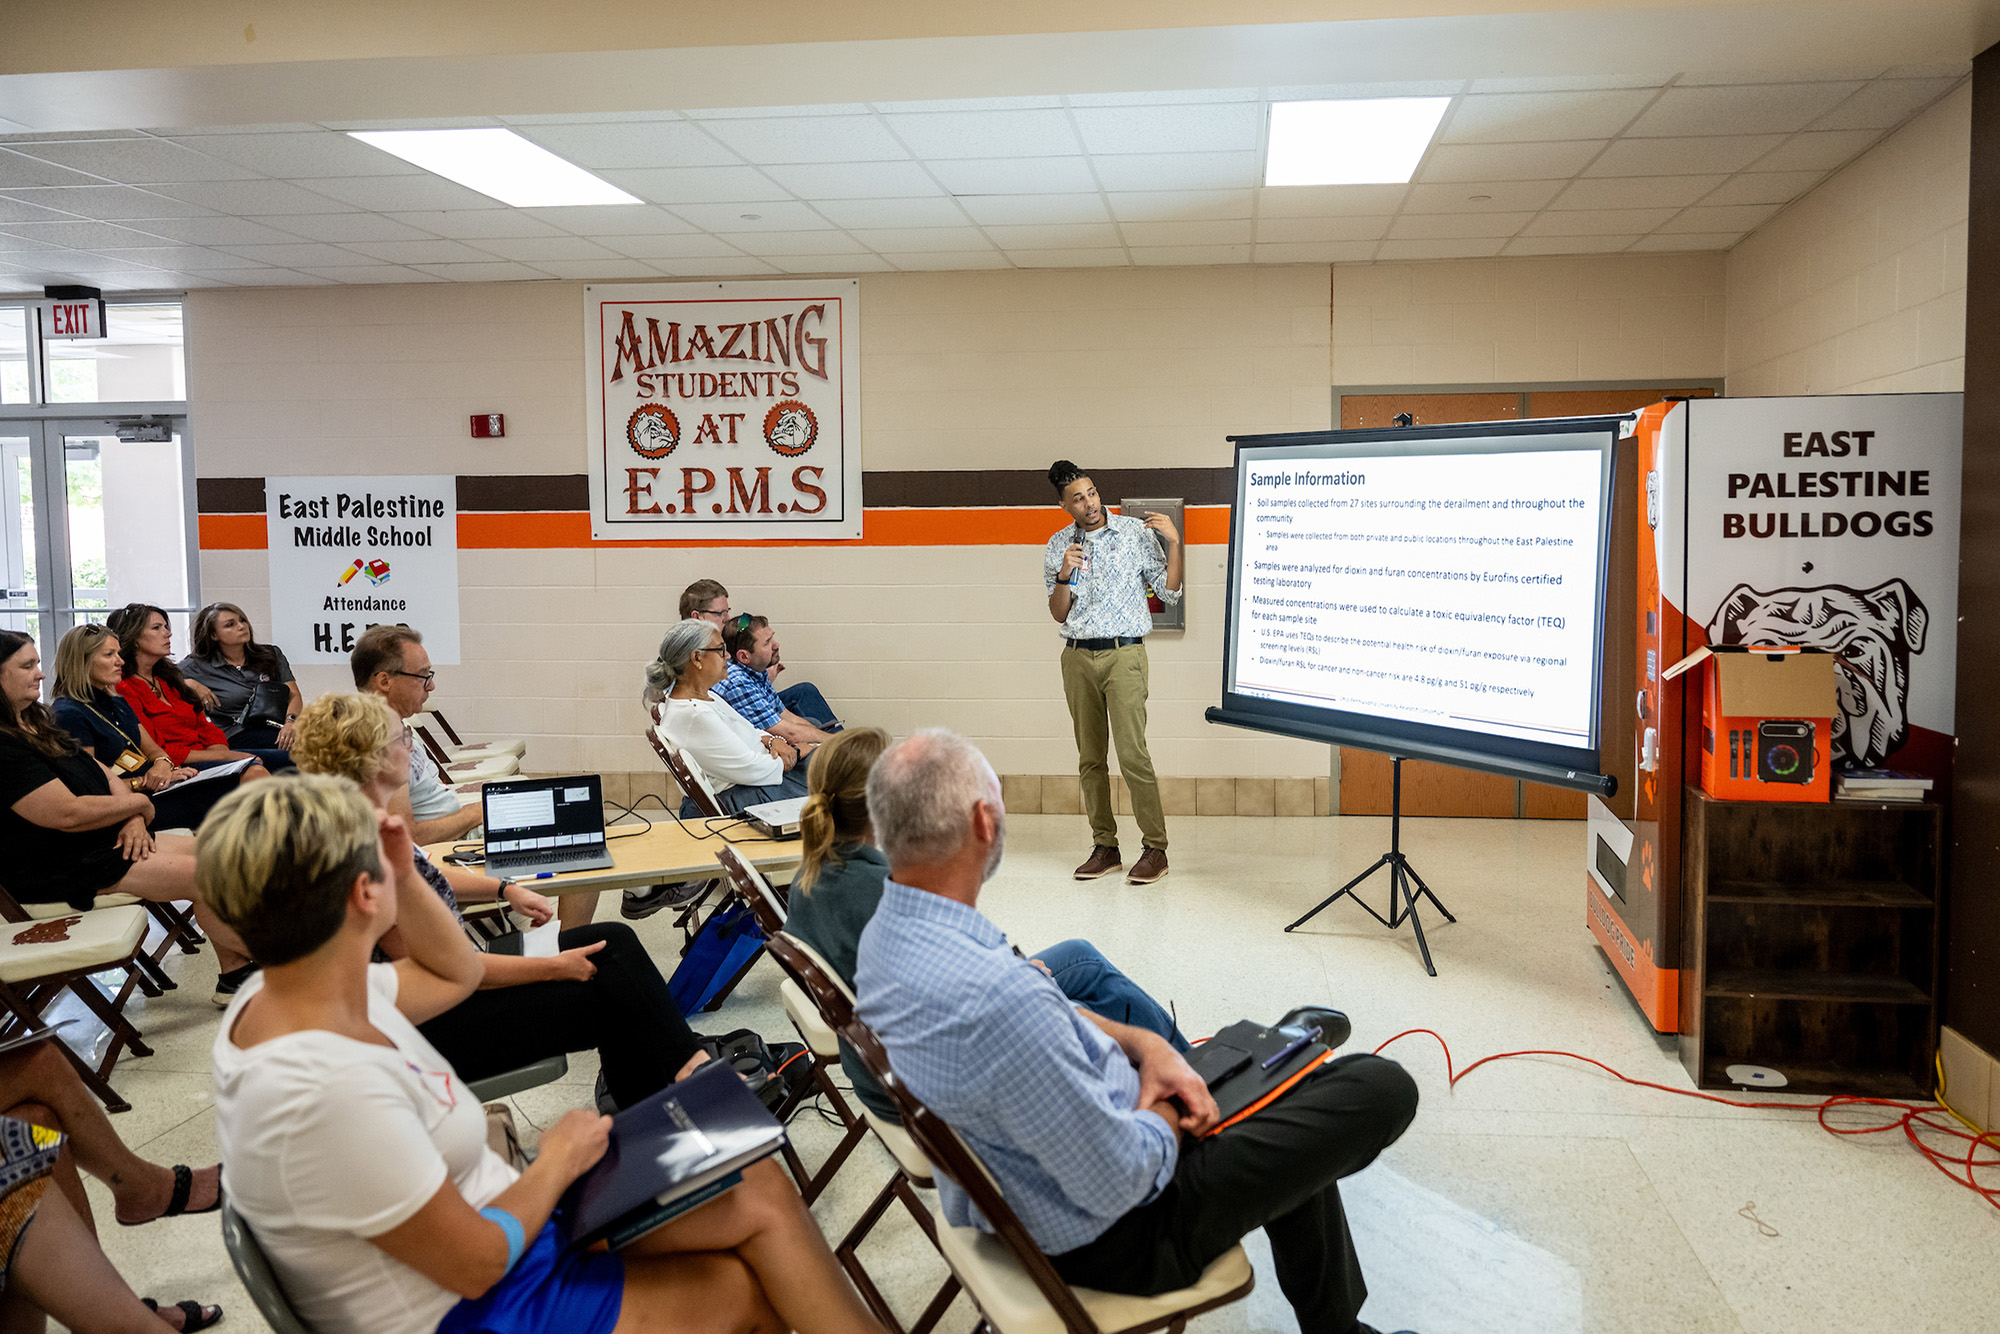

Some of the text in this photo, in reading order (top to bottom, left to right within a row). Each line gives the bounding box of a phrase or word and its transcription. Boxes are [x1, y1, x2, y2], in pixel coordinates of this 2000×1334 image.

[53, 304, 89, 334] EXIT
[610, 304, 829, 382] AMAZING
[636, 370, 800, 399] STUDENTS
[693, 412, 745, 444] AT
[1783, 431, 1875, 457] EAST
[624, 465, 828, 515] E.P.M.S
[1250, 470, 1365, 488] Sample Information
[1727, 470, 1930, 498] PALESTINE
[279, 492, 445, 519] East Palestine
[1257, 497, 1585, 511] Soil samples collected from 27 sites surrounding the derailment and throughout the
[1256, 515, 1293, 524] community
[1722, 510, 1933, 538] BULLDOGS
[294, 525, 432, 547] Middle School
[1266, 530, 1289, 539] Samples
[1305, 532, 1332, 540] collected
[1333, 532, 1348, 540] from
[1350, 533, 1364, 541] both
[1366, 534, 1388, 542] private
[1403, 535, 1424, 543] public
[1425, 536, 1457, 544] locations
[1458, 536, 1500, 546] throughout
[1501, 537, 1514, 546] the
[1515, 536, 1533, 546] East
[1535, 536, 1573, 546] Palestine
[1253, 560, 1562, 585] Samples were analyzed for dioxin and furan concentrations by Eurofins certified
[1253, 576, 1312, 589] testing laboratory
[323, 594, 407, 612] Attendance
[1252, 595, 1565, 630] Measured concentrations were used to calculate a toxic equivalency factor (TEQ)
[1251, 609, 1317, 625] for each sample site
[1260, 642, 1287, 653] screening
[1288, 644, 1304, 653] levels
[1272, 629, 1284, 637] EPA
[1300, 631, 1314, 641] TEQs
[1315, 634, 1322, 642] to
[1323, 635, 1349, 644] describe
[1350, 637, 1361, 646] the
[1362, 639, 1391, 648] potential
[1392, 641, 1414, 650] health
[1415, 644, 1427, 652] risk
[1428, 644, 1436, 653] of
[1437, 647, 1481, 657] dioxin/furan
[1483, 651, 1518, 662] exposure
[1519, 655, 1531, 663] via
[1532, 656, 1567, 667] regional
[1259, 656, 1294, 667] Dioxin/furan
[1296, 659, 1306, 669] RSL
[1307, 661, 1316, 670] for
[1317, 664, 1338, 672] cancer
[1338, 666, 1350, 674] and
[1351, 668, 1387, 679] non-cancer
[1388, 672, 1400, 680] risk
[1401, 674, 1413, 682] are
[1444, 679, 1457, 687] and
[1459, 679, 1468, 689] 51
[1488, 685, 1534, 698] respectively
[1589, 888, 1635, 971] BULLDOG PRIDE
